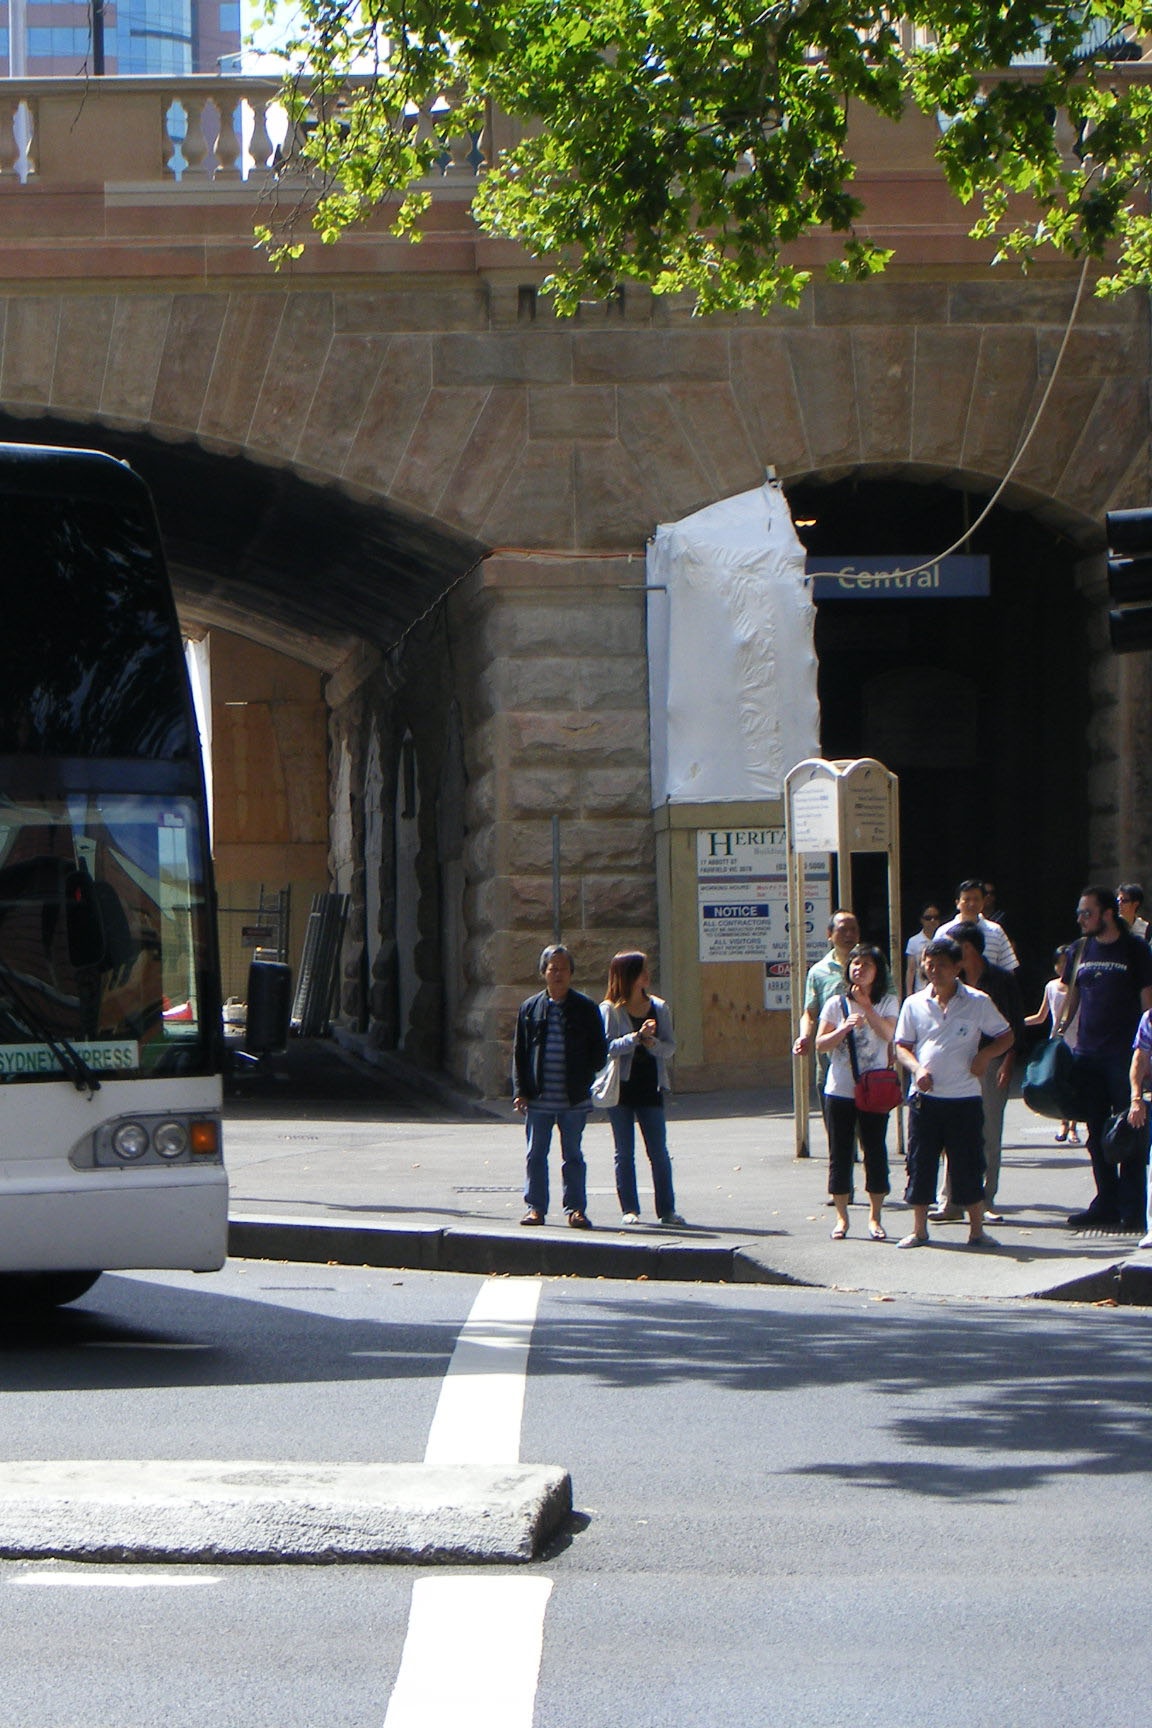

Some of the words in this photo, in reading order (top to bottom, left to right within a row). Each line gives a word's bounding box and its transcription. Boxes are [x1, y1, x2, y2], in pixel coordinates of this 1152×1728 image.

[838, 564, 940, 588] Central
[714, 906, 758, 917] NOTICE
[772, 942, 789, 950] MUS
[61, 1047, 132, 1069] PRESS
